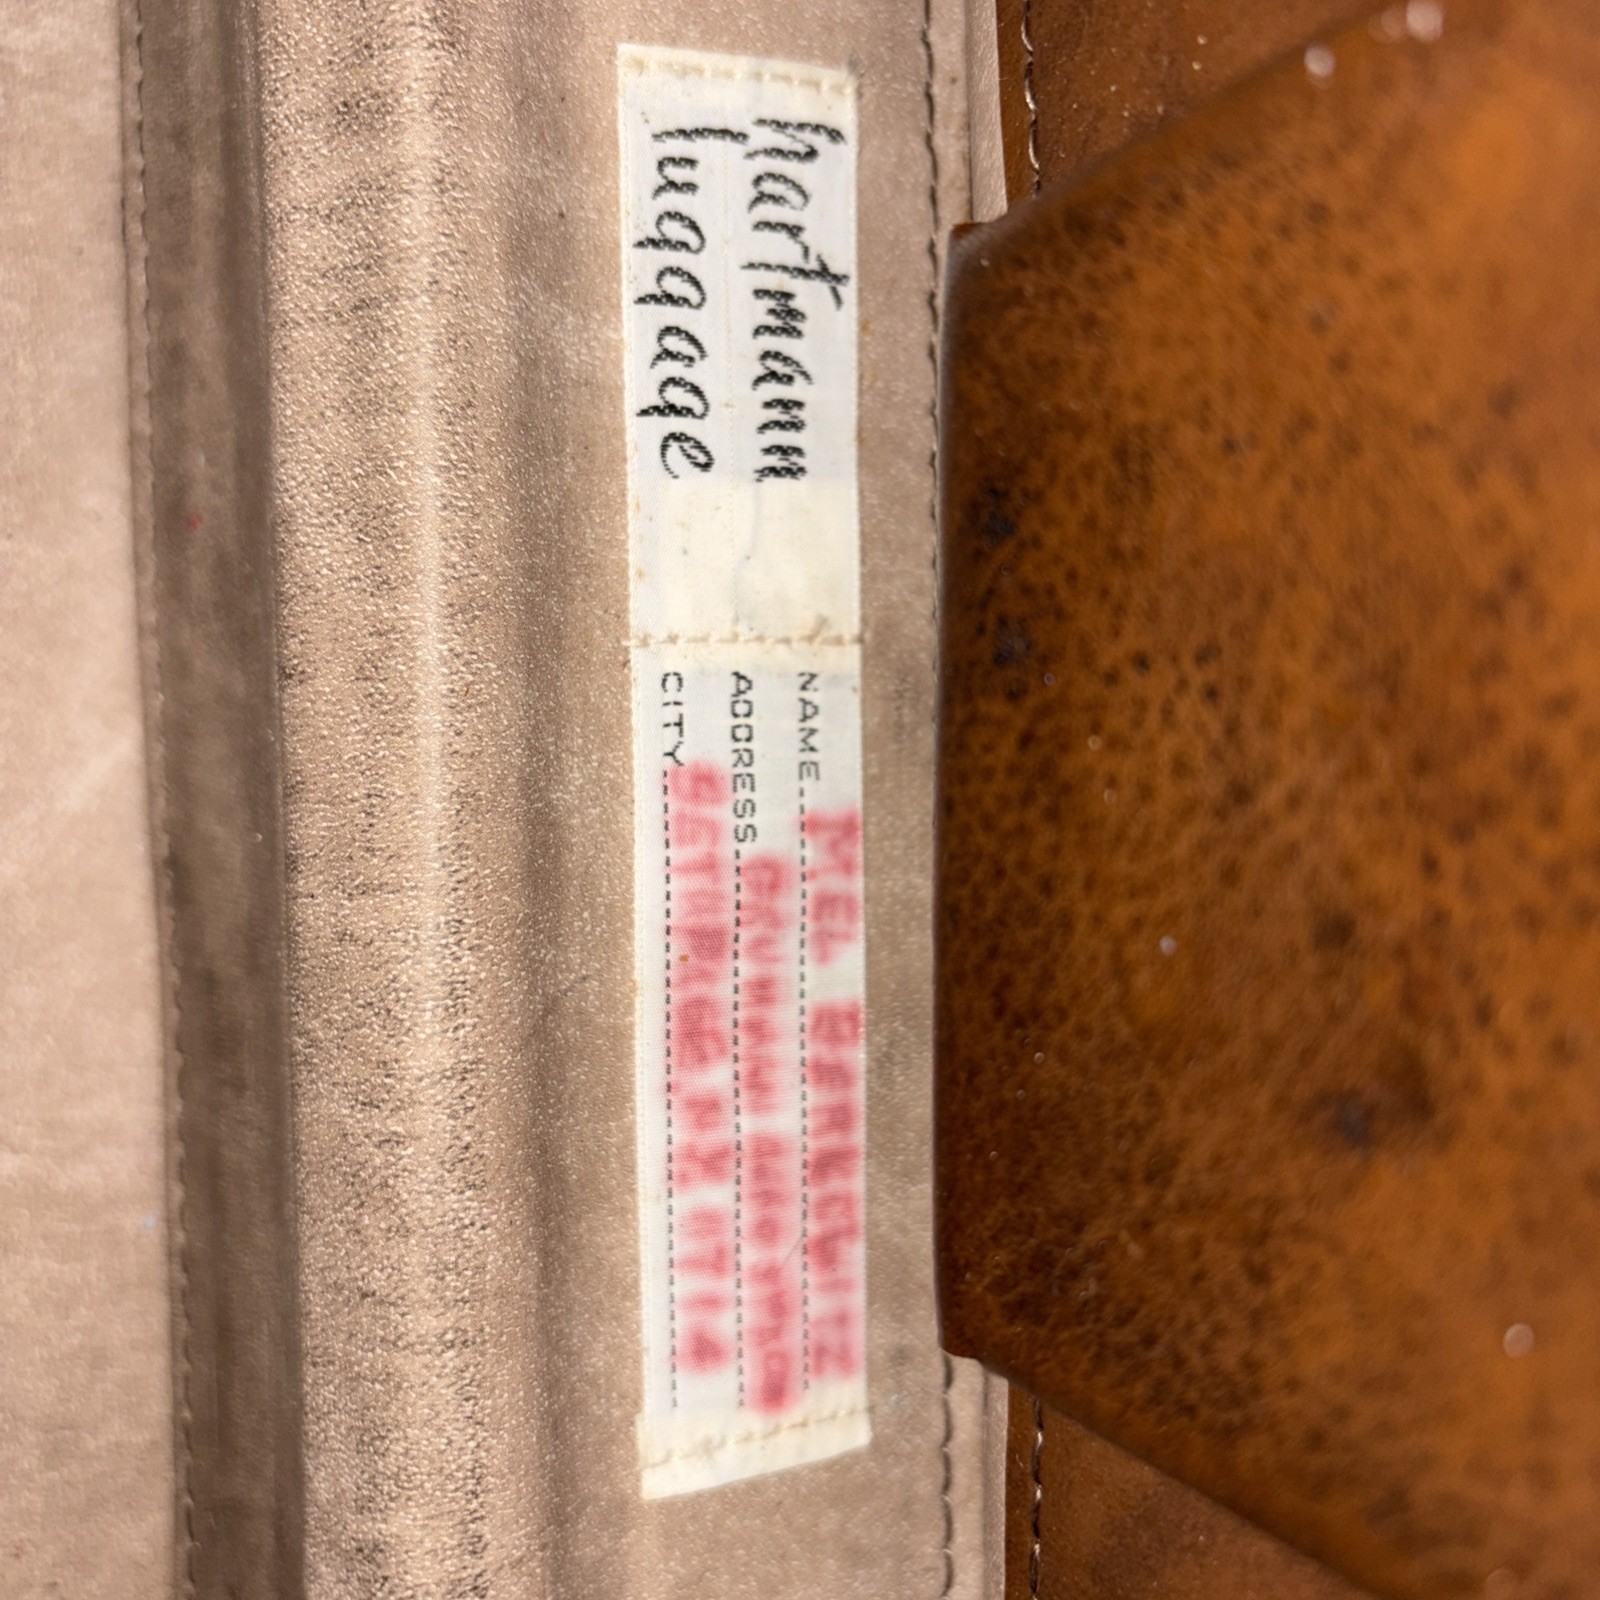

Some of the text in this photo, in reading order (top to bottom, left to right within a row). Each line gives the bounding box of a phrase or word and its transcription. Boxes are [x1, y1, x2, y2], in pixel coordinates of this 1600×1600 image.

[633, 126, 749, 479] luggage
[739, 117, 850, 482] hartmann
[661, 671, 686, 768] CITY
[731, 671, 757, 844] ADDRESS
[798, 671, 821, 782] NAME
